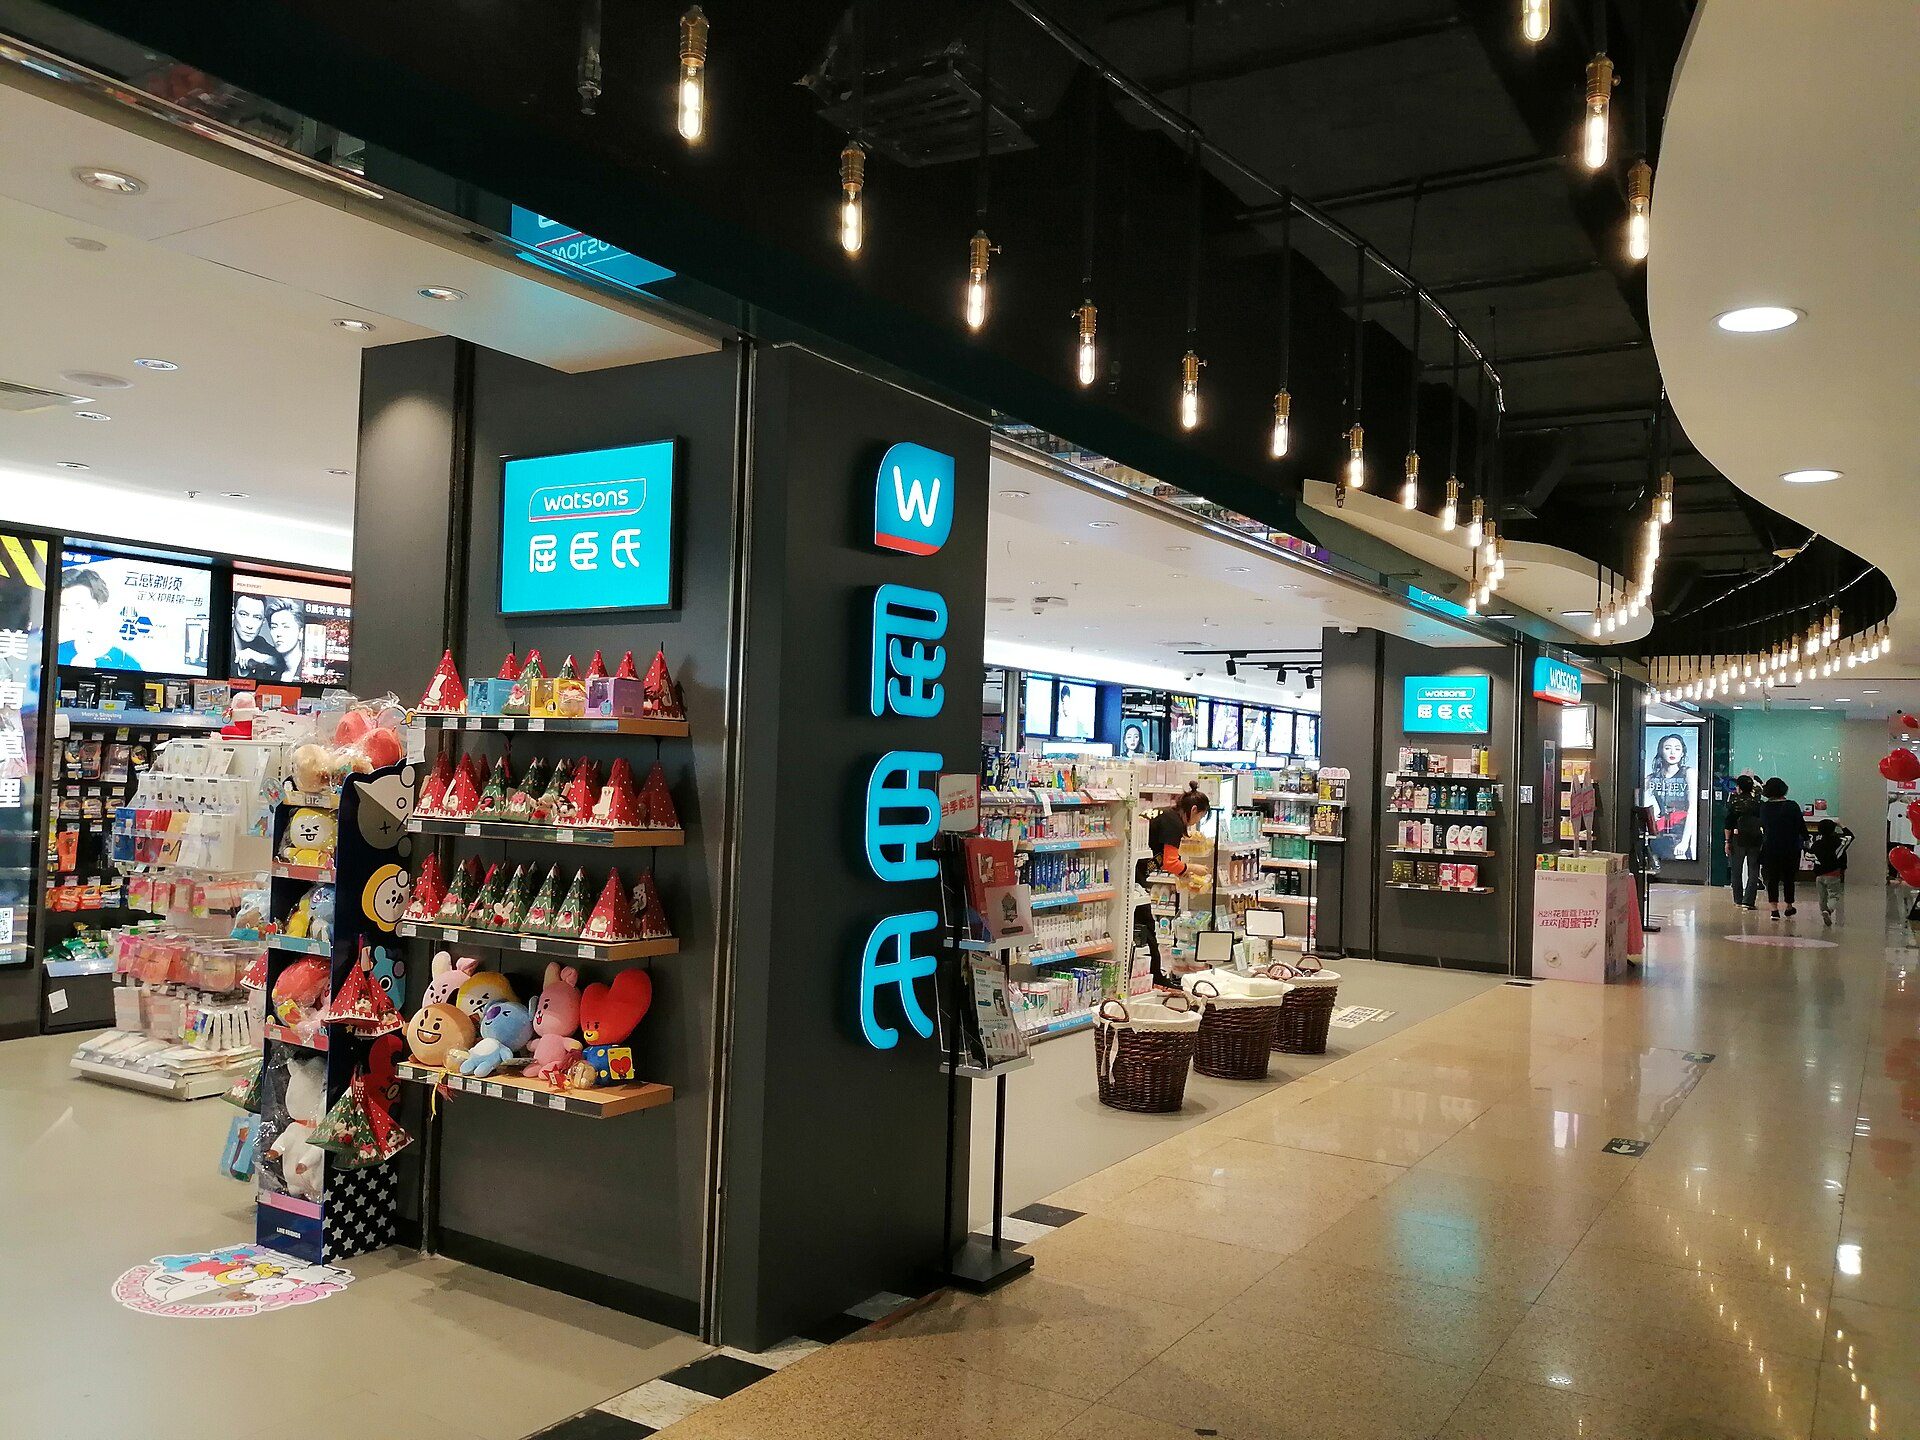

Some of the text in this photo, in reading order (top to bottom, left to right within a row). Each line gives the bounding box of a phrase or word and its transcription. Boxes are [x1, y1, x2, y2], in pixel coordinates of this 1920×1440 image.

[543, 487, 630, 513] watsons
[892, 465, 942, 528] W
[529, 528, 641, 573] 屈臣氏
[1424, 688, 1467, 698] watsons
[1549, 666, 1578, 694] watsons
[1417, 704, 1473, 720] 屈臣氏
[859, 583, 948, 1050] 屈臣氏
